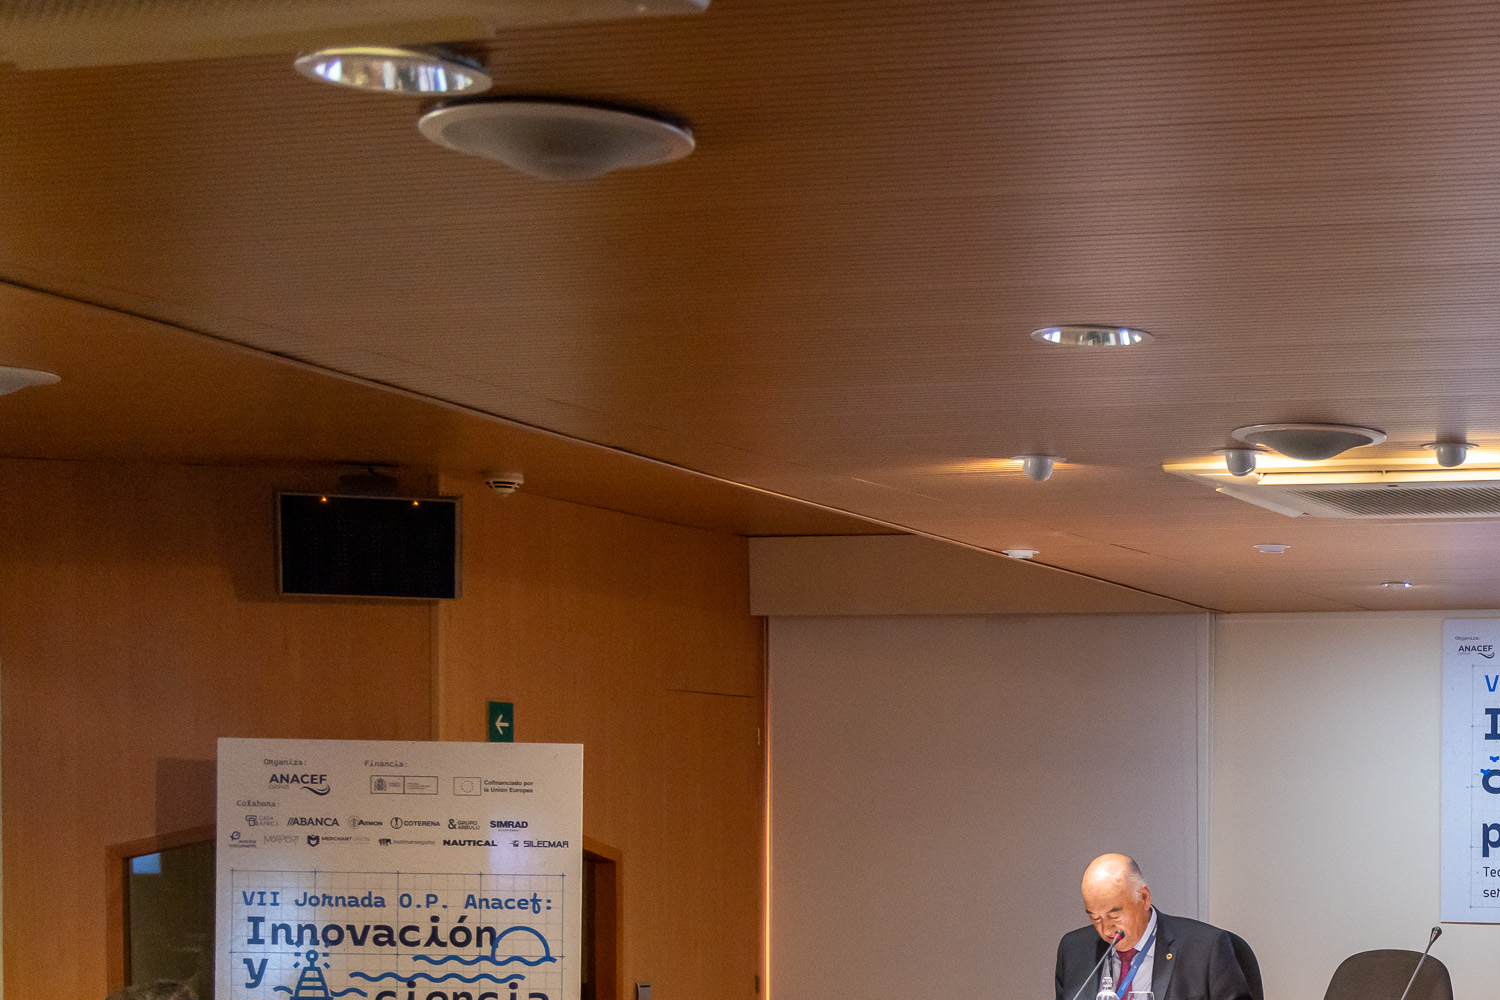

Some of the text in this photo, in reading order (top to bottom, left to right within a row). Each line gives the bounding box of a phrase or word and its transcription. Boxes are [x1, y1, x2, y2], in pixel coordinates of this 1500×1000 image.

[264, 758, 307, 766] Organiza:
[269, 774, 327, 784] ANACEF
[523, 840, 568, 848] SILECMAR
[242, 890, 552, 914] VII Jornada O.P. Anacef:
[247, 915, 498, 948] Innovación
[243, 958, 268, 988] y
